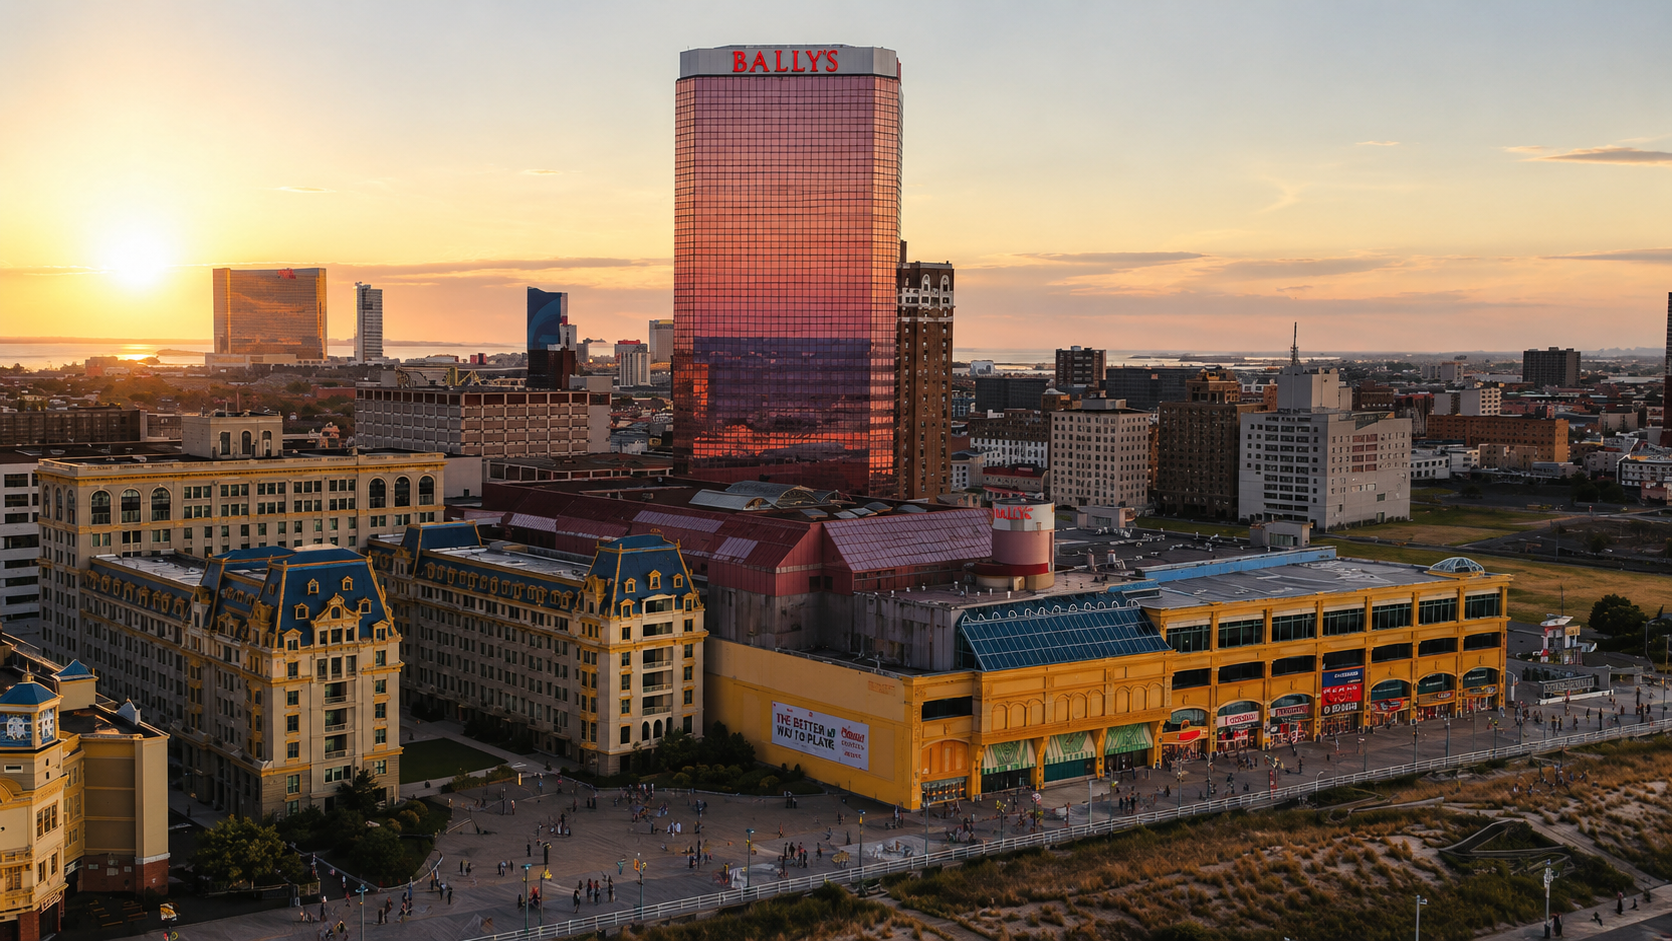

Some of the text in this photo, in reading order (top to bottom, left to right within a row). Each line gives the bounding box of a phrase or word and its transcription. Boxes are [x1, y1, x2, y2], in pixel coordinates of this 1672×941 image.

[732, 49, 839, 73] BALLY'S
[776, 712, 791, 726] THE
[793, 717, 825, 737] BETTER
